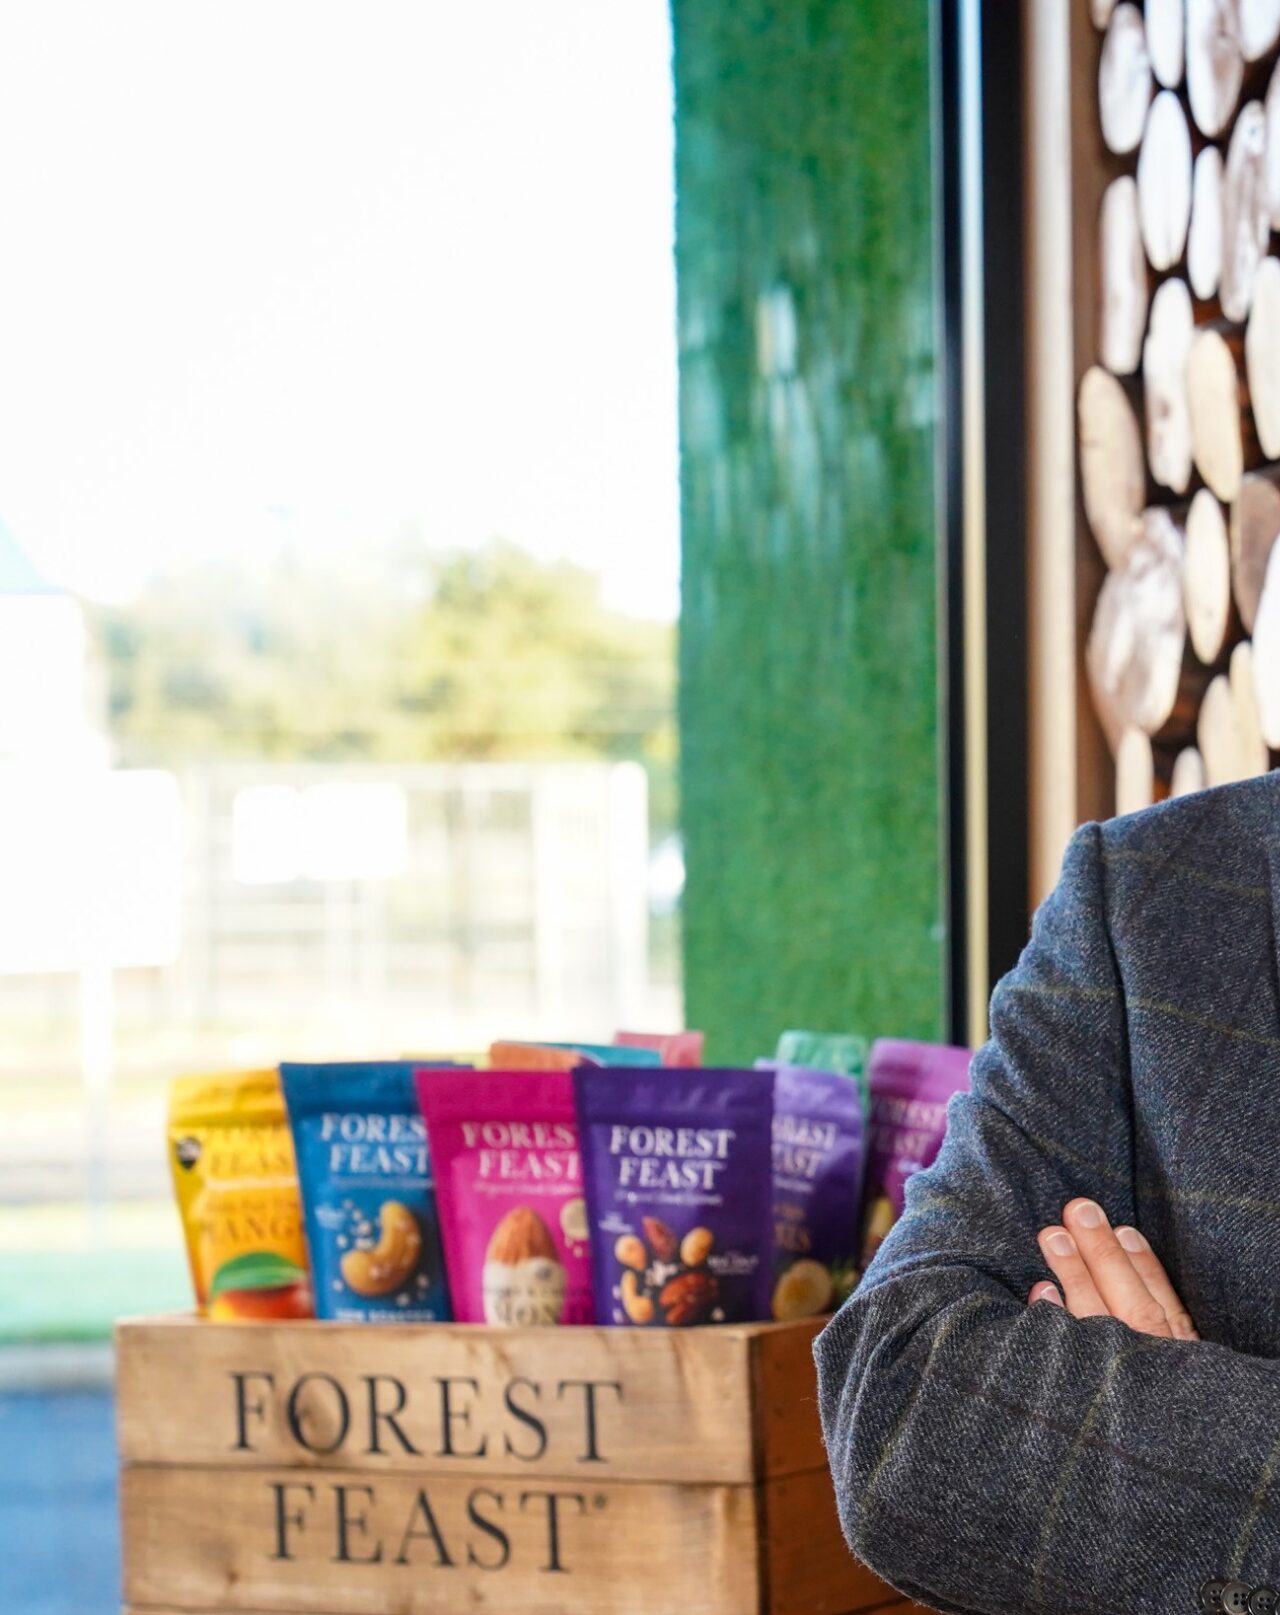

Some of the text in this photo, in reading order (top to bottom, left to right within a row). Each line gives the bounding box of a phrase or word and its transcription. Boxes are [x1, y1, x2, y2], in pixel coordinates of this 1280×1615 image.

[321, 1112, 428, 1142] FORES
[462, 1120, 576, 1150] FORES
[610, 1124, 736, 1159] FOREST
[619, 1157, 727, 1190] FEAST
[228, 1372, 622, 1463] FOREST
[269, 1481, 584, 1574] FEAST
